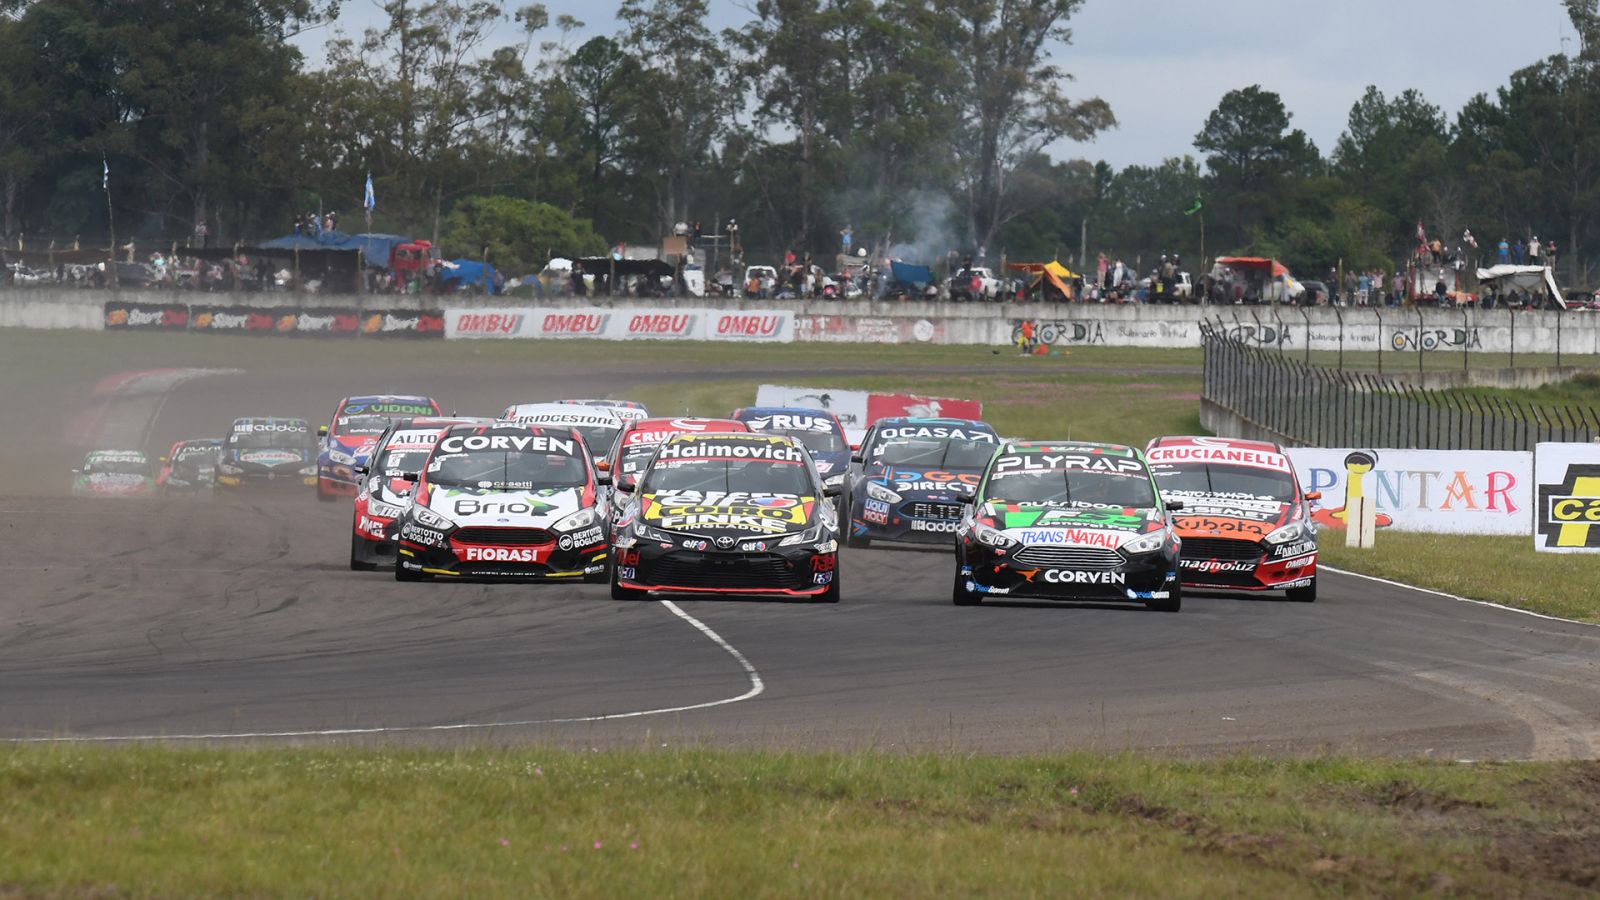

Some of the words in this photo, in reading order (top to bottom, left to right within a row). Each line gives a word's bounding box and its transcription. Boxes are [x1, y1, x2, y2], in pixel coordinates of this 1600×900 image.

[457, 313, 518, 333] OMBU
[542, 314, 602, 333] OMBU
[628, 314, 689, 333] OMBU
[716, 315, 778, 335] OMBU
[371, 404, 433, 415] VIDONI
[773, 414, 833, 431] RUS
[394, 434, 438, 444] AUTO
[881, 427, 967, 440] OCASA
[440, 435, 574, 456] CORVEN
[659, 443, 803, 461] Haimovich
[997, 455, 1143, 473] PLYRAP
[1150, 449, 1284, 467] CRUCIANELLI
[454, 500, 530, 517] Brio
[659, 506, 793, 519] COIRO
[662, 515, 788, 532] FINKE
[1174, 518, 1268, 536] Kubota
[410, 525, 443, 540] BERTOTTO
[572, 526, 602, 541] BERTOTTO
[574, 533, 605, 548] BOGLIONE
[1020, 531, 1065, 545] TRANS
[1064, 529, 1120, 549] NATALI
[682, 540, 698, 549] elf
[742, 542, 757, 551] elf
[466, 548, 537, 562] FIORASI
[1179, 558, 1256, 572] magnoluz
[1044, 568, 1126, 585] CORVEN
